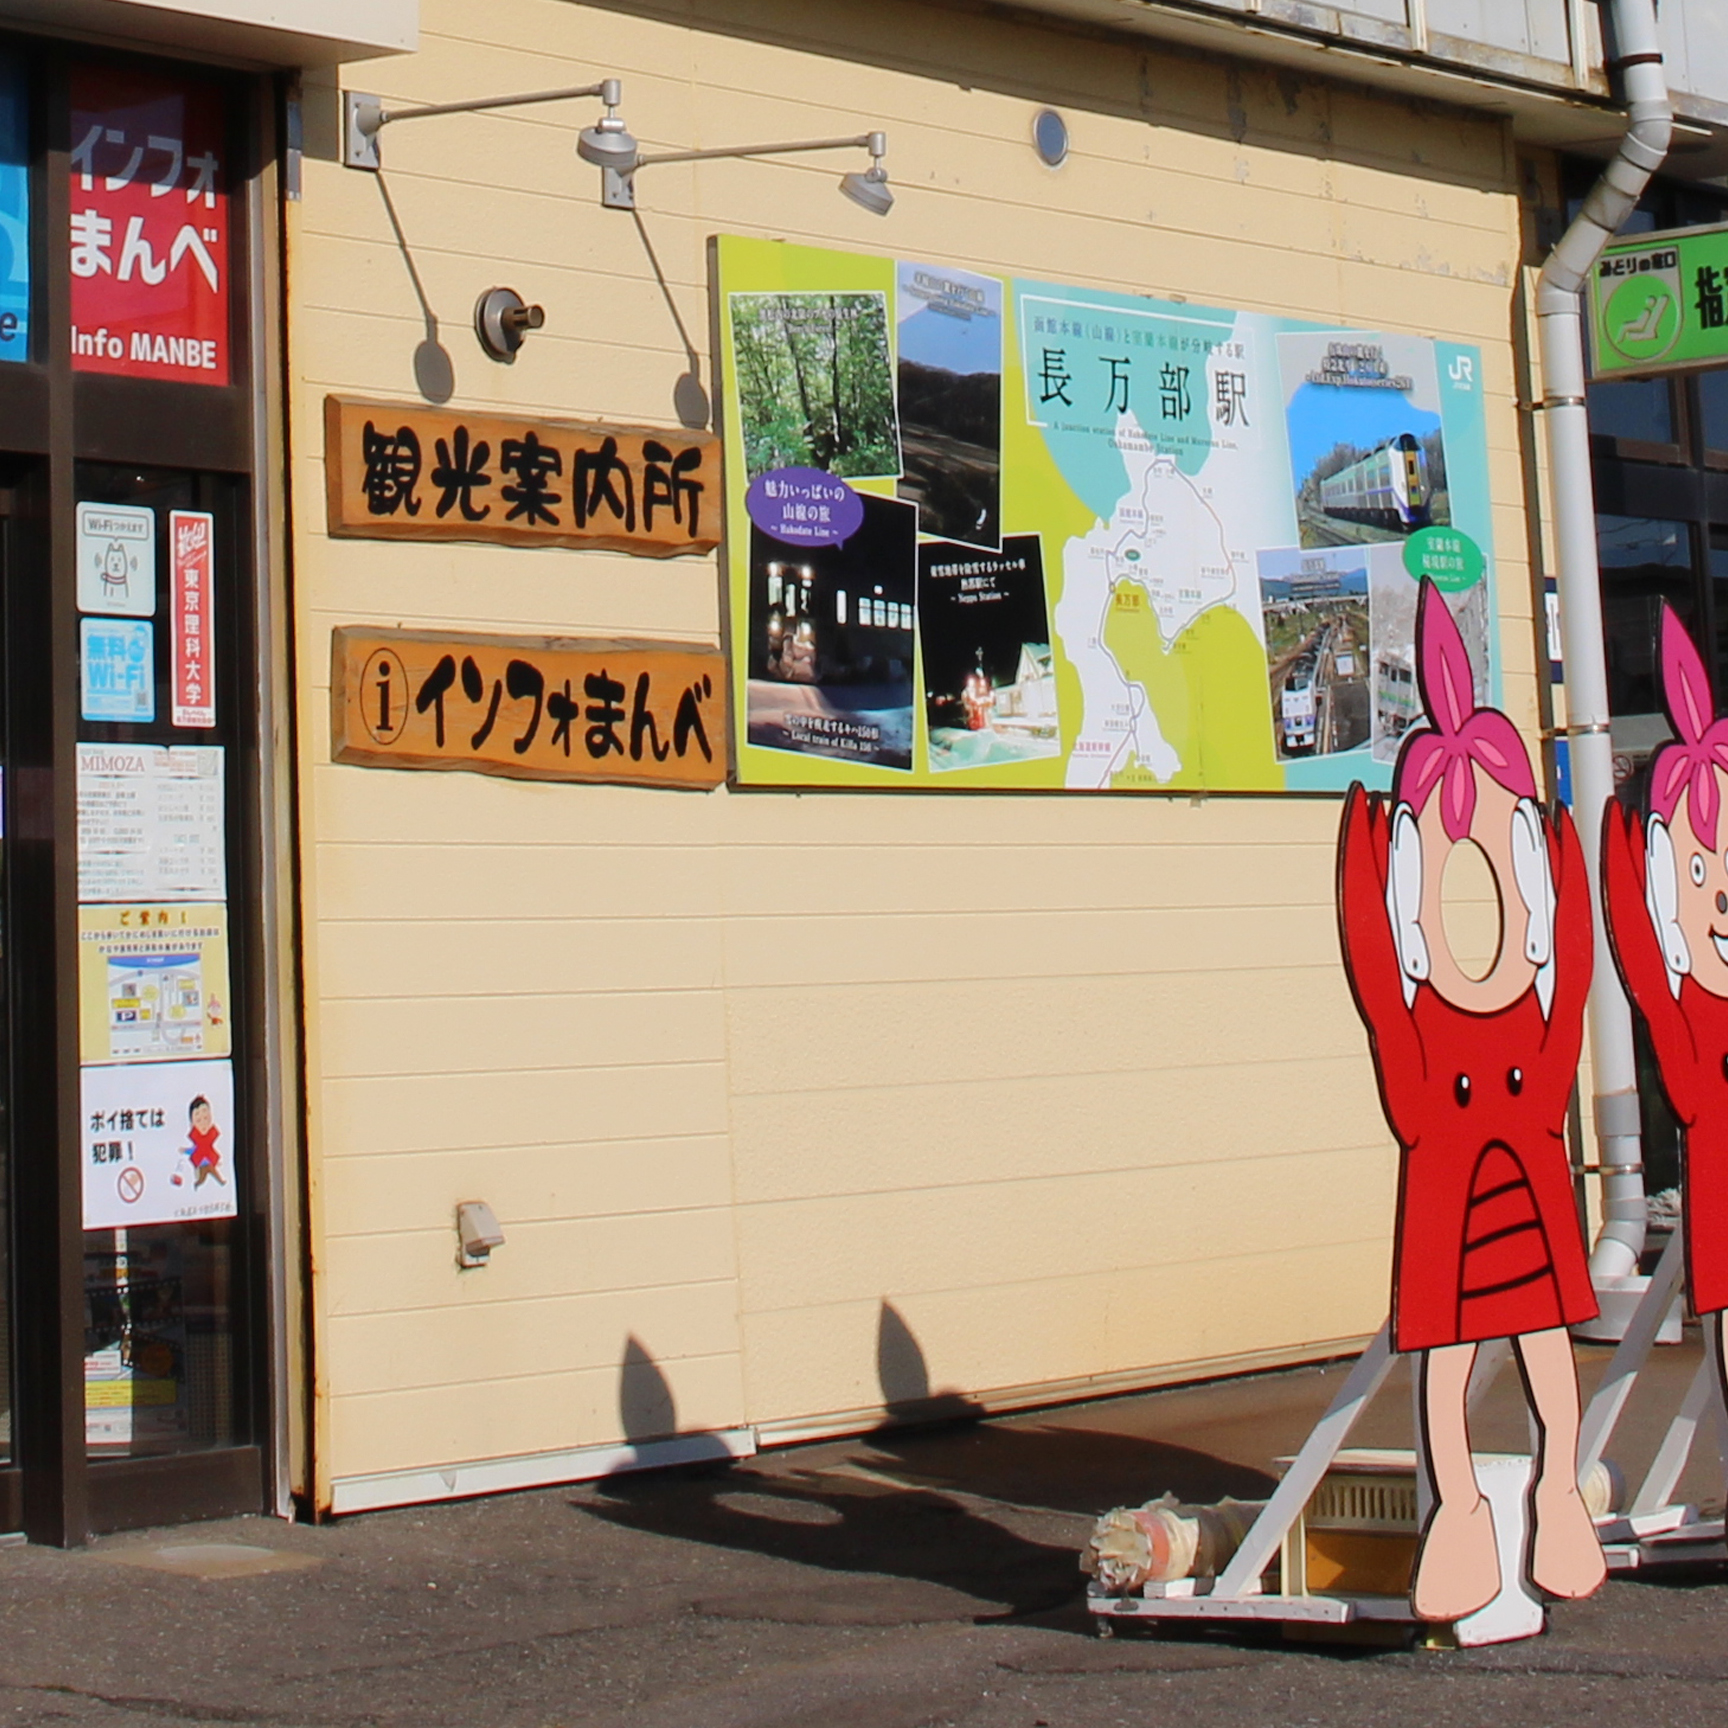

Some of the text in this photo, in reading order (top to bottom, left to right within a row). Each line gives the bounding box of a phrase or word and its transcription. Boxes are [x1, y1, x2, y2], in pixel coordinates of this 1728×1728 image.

[69, 122, 220, 210] インフォ
[69, 208, 220, 294] まんべ
[1598, 250, 1678, 278] みどりの窓口
[70, 325, 218, 371] Info MANBE
[1448, 355, 1473, 382] JR
[1037, 346, 1251, 427] 長万部駅
[361, 419, 705, 539] 観光案内所
[765, 478, 845, 502] 魅力いっぱいの
[782, 502, 831, 523] 山線の旅
[814, 526, 830, 538] Line
[183, 568, 203, 705] 東京理科大学
[87, 663, 145, 691] Wi-Fi
[414, 653, 714, 764] インフォまんべ
[80, 756, 146, 773] MIMOZA
[90, 1108, 166, 1133] ポイ捨ては
